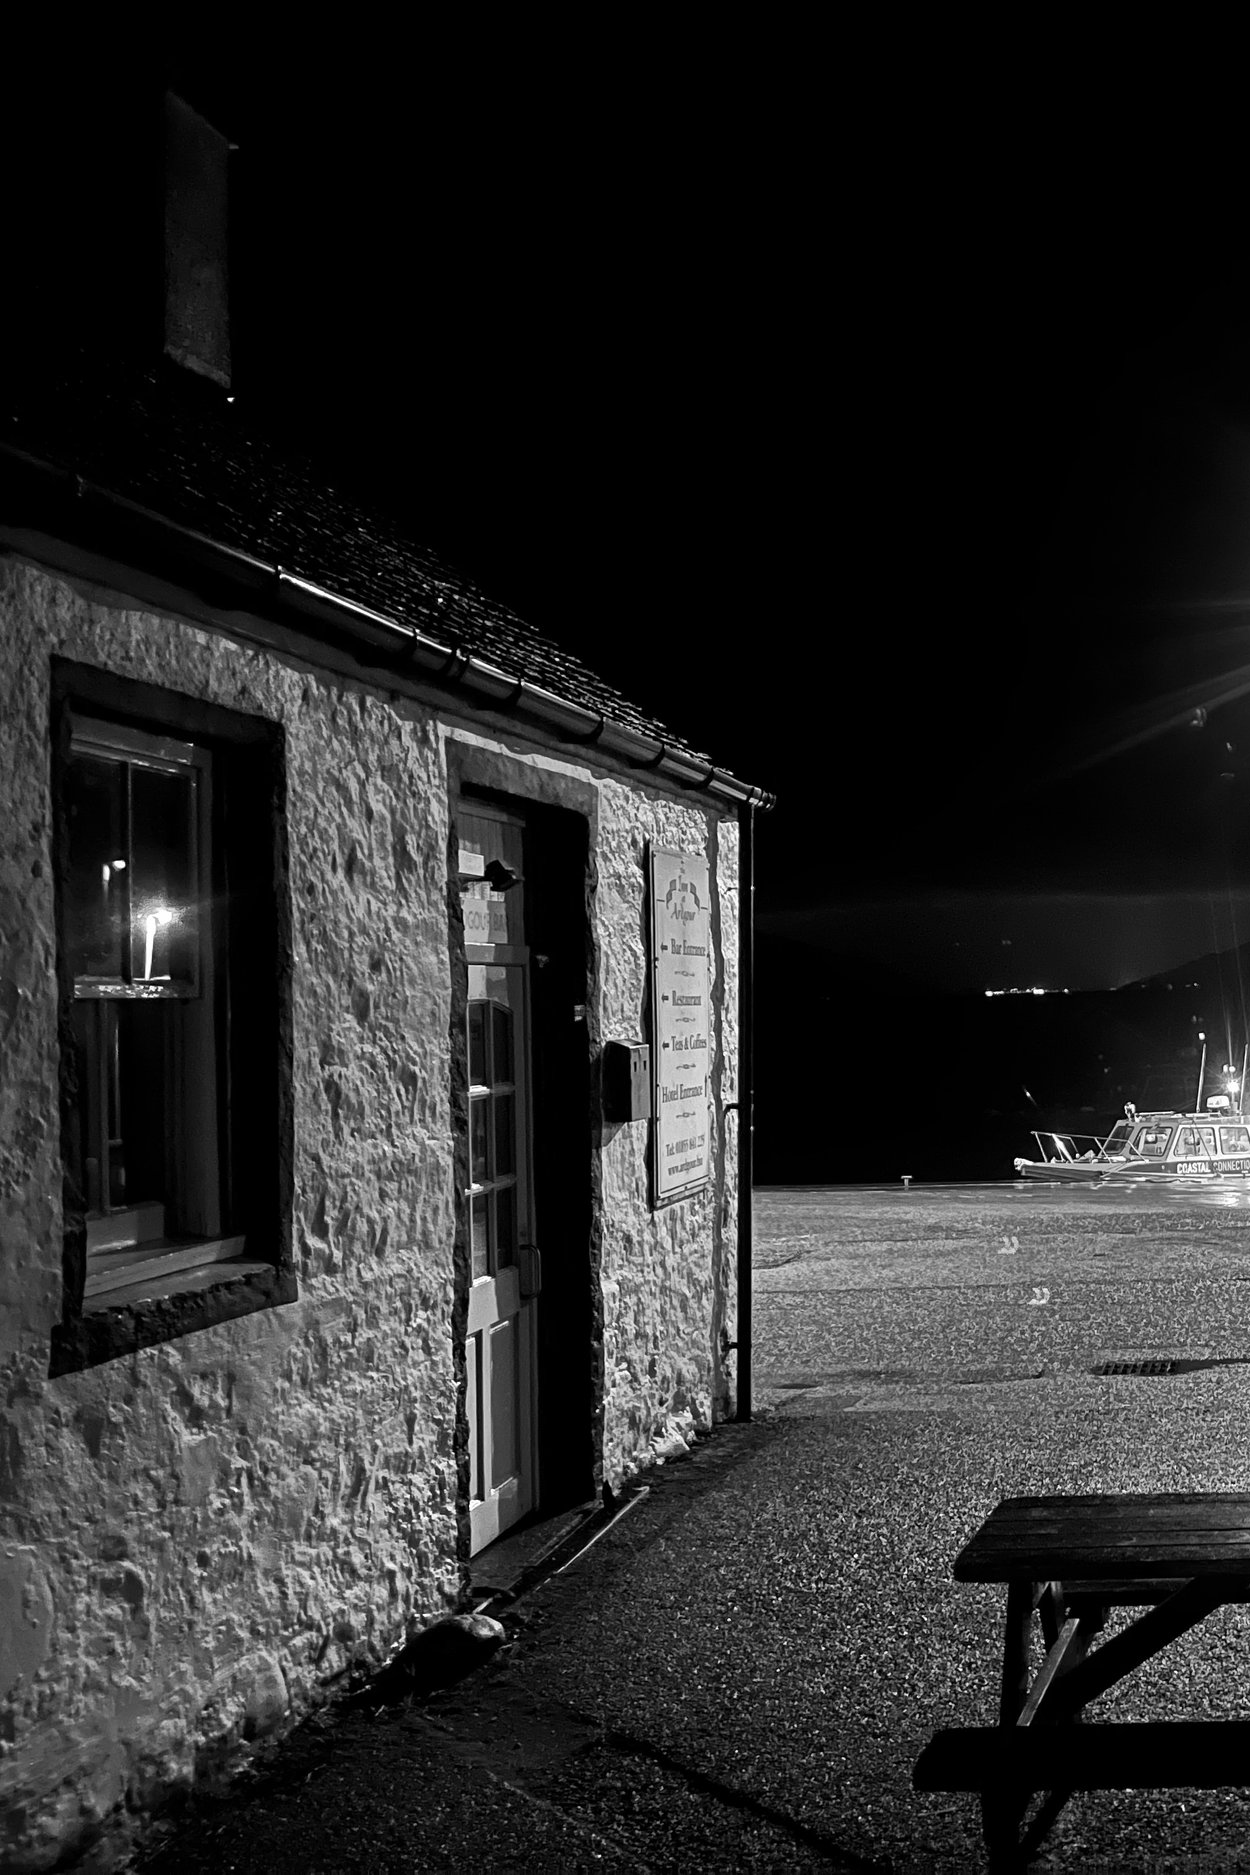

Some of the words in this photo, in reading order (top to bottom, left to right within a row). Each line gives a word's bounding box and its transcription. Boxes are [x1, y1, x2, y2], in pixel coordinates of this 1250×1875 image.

[671, 938, 682, 955] Bar
[682, 939, 706, 957] Entrance
[672, 990, 702, 1006] Restaurant
[671, 1035, 683, 1052] Teas
[684, 1036, 689, 1050] &
[689, 1033, 707, 1050] Coffees
[662, 1084, 679, 1103] Hotel
[679, 1083, 703, 1100] Entrance
[1176, 1161, 1211, 1174] COASTAL
